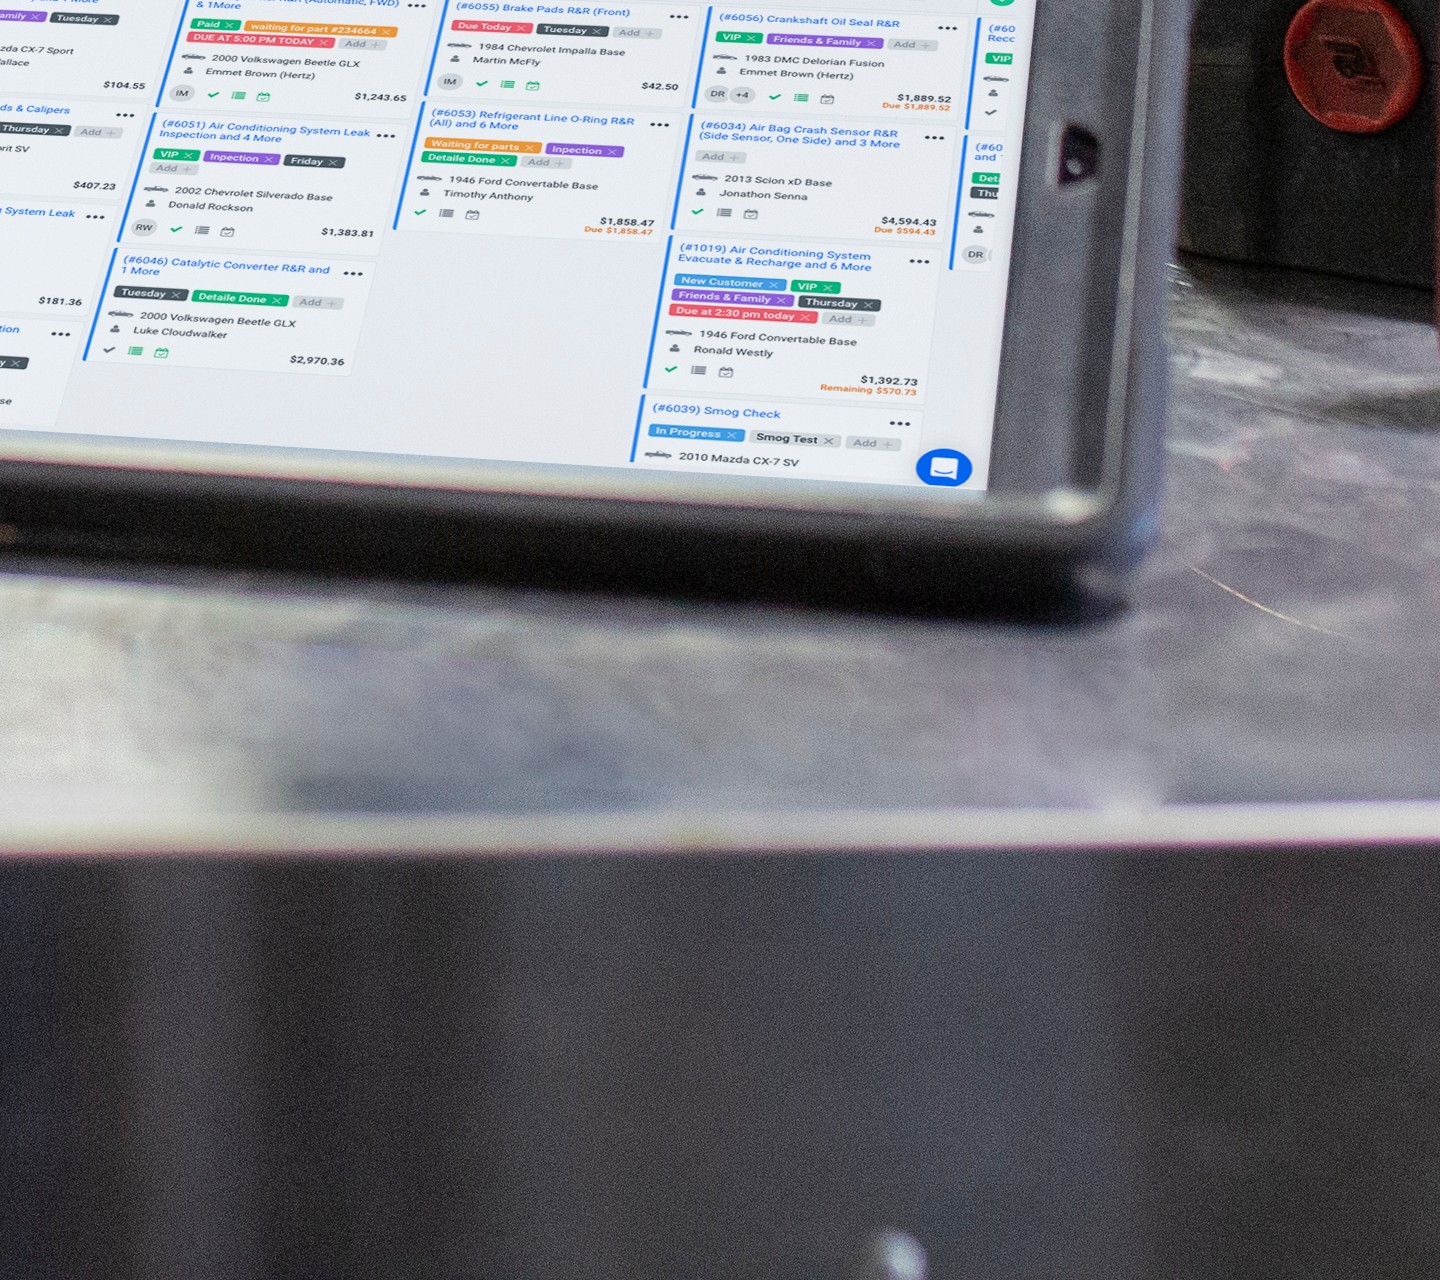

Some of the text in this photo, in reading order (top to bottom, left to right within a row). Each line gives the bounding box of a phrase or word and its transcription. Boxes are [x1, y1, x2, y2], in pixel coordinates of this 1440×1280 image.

[455, 1, 631, 18] (#6055) Brake Pads R&R (Front)
[56, 13, 99, 24] Tuesday
[718, 12, 900, 28] (#6056) Crankshaft Oil Seal R&R
[196, 20, 221, 30] Paid
[250, 23, 377, 35] waiting for part #234664
[457, 21, 512, 33] Due Today
[472, 55, 541, 67] Martin McFly
[205, 67, 316, 81] Emmet Brown (Hertz)
[102, 80, 146, 90] $104.55
[641, 81, 679, 91] $42.50
[353, 91, 407, 102] $1,243.65
[897, 92, 952, 104] $1,889.52
[15, 104, 24, 112] &
[25, 104, 70, 115] Calipers
[881, 101, 951, 112] Due $1,889.52
[431, 107, 635, 126] (#6053) Refrigerant Line O-Ring R&R
[2, 122, 50, 135] Thursday
[161, 119, 370, 137] (#6051) Air Conditioning System Leak
[700, 120, 899, 138] (#6034) Air Bag Crash Sensor R&R
[72, 180, 117, 191] $407.23
[443, 189, 534, 203] Timothy Anthony
[719, 189, 808, 201] Jonathon Senna
[4, 206, 46, 217] System
[48, 208, 76, 218] Leak
[167, 200, 254, 212] Donald Rockson
[599, 216, 655, 227] $1,858.47
[881, 215, 937, 227] $4,594.43
[320, 226, 374, 238] $1,383.81
[583, 225, 654, 236] Due $1,858.47
[679, 242, 871, 261] (#1019) Air Conditioning System
[122, 254, 331, 275] (#6046) Catalytic Converter R&R and
[680, 276, 764, 288] New Customer
[37, 295, 83, 307] $181.36
[132, 325, 228, 339] Luke Cloudwalker
[693, 344, 774, 359] Ronald Westly
[289, 354, 345, 366] $2,970.36
[860, 374, 918, 387] $1,392.73
[652, 402, 781, 419] (#6039) Smog Check
